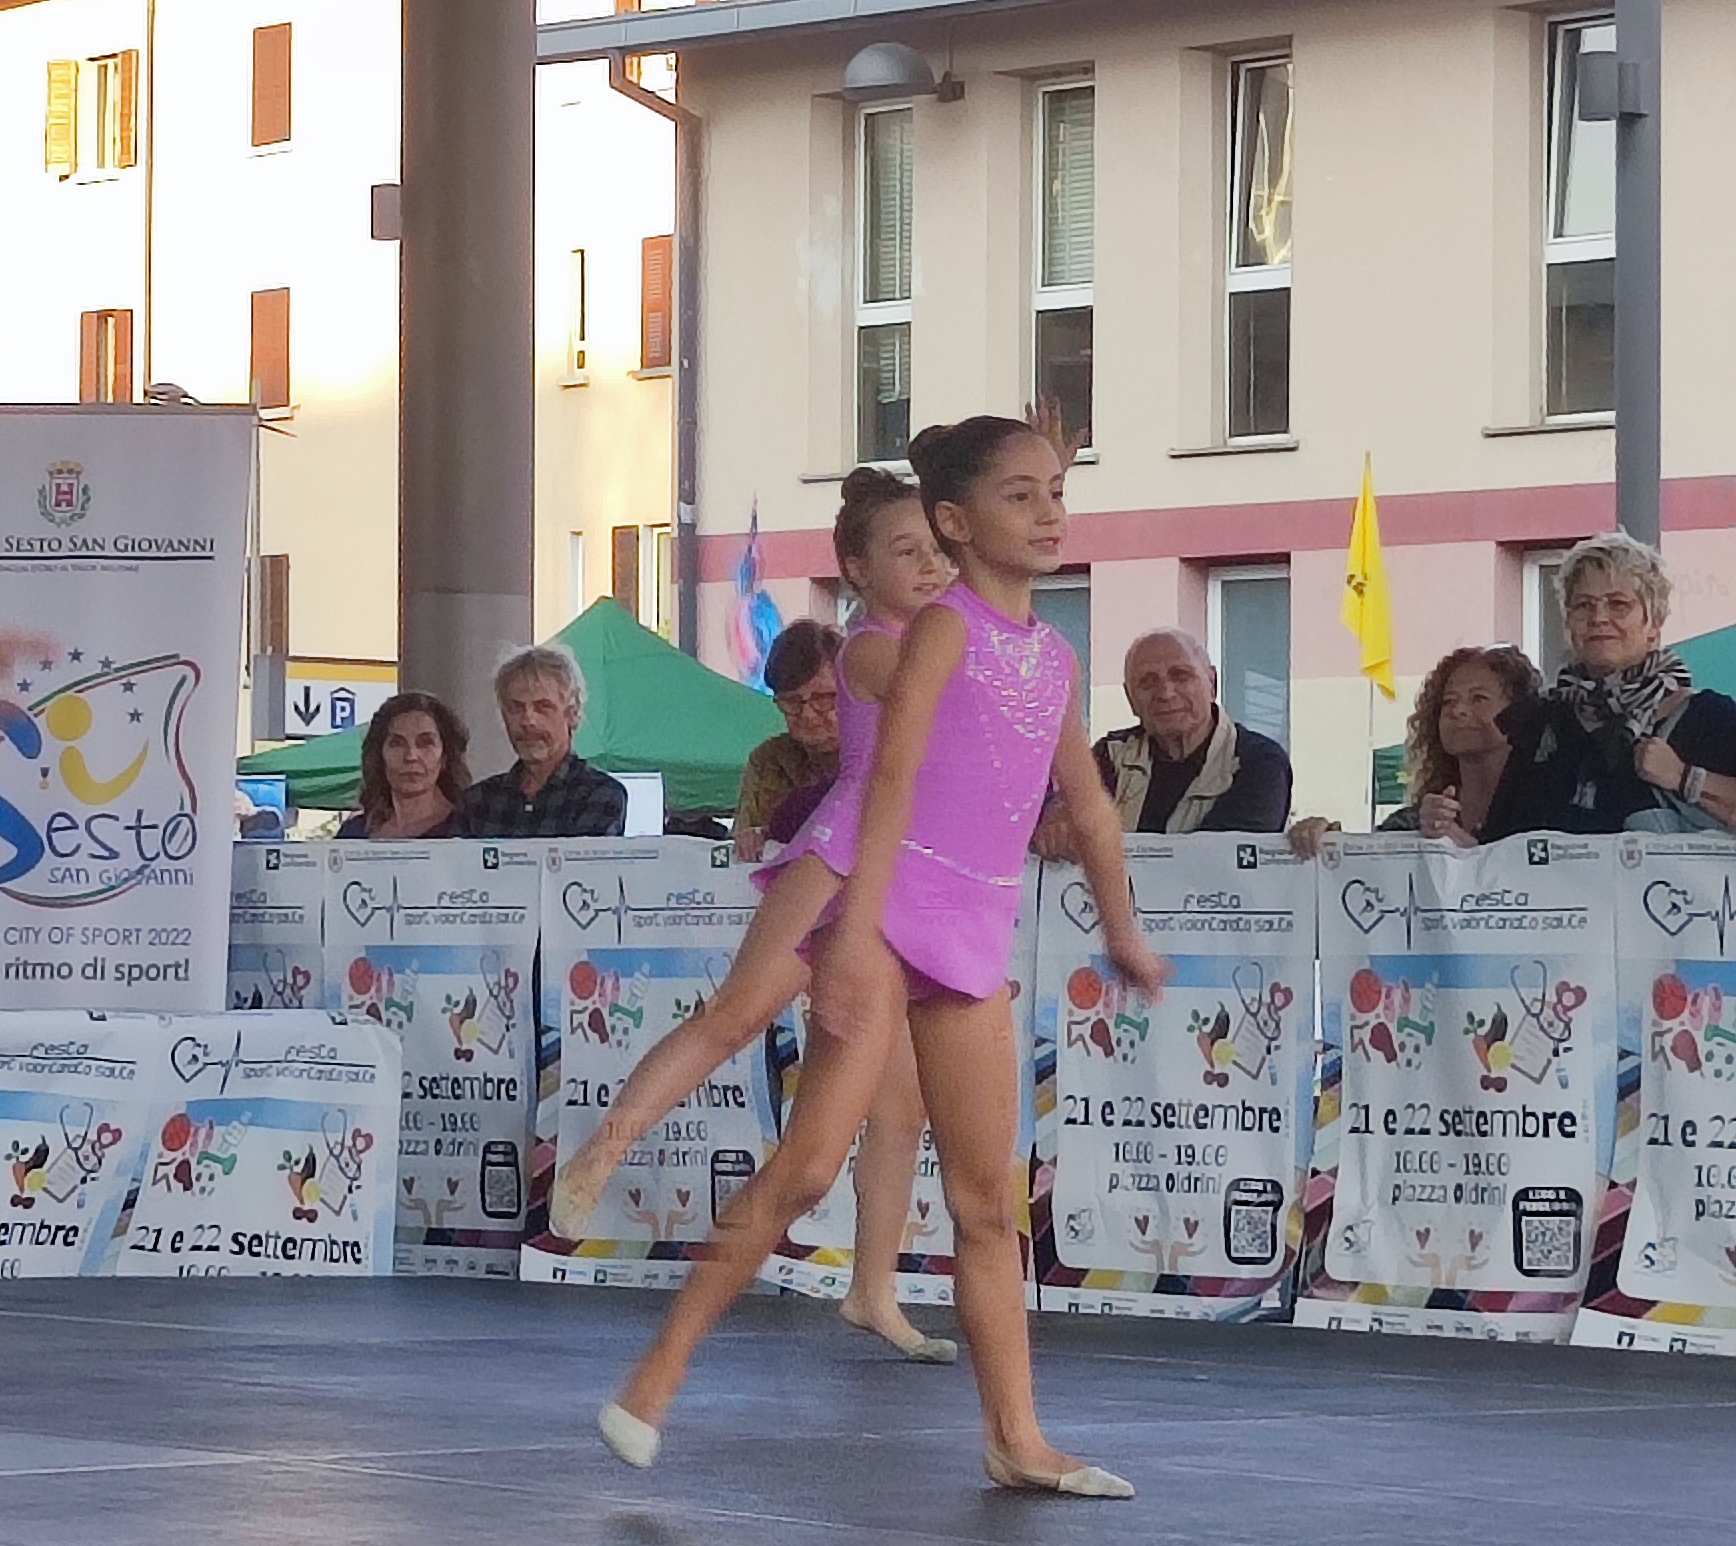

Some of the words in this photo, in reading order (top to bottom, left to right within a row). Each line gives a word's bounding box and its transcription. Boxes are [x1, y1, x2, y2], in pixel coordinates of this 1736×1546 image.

[3, 534, 63, 553] SESTO
[67, 534, 106, 553] SAN
[112, 534, 215, 553] GIOVANNI
[334, 699, 351, 726] P
[3, 927, 42, 946] CITY
[48, 927, 76, 946] OF
[82, 928, 142, 946] SPORT
[147, 928, 193, 946] 2022
[4, 957, 73, 981] ritmo
[80, 956, 106, 982] di
[113, 958, 190, 987] sport!
[418, 1071, 518, 1101] settembre
[566, 1078, 591, 1107] 21
[596, 1083, 610, 1107] e
[1064, 1094, 1093, 1126] 21
[1100, 1101, 1115, 1127] e
[1122, 1096, 1145, 1127] 22
[1150, 1099, 1282, 1133] settembre
[1348, 1102, 1375, 1135] 21
[1383, 1108, 1398, 1136] e
[1403, 1103, 1431, 1136] 22
[1438, 1104, 1578, 1139] settembre
[1646, 1112, 1673, 1147] 21
[1680, 1119, 1697, 1148] e
[1113, 1140, 1153, 1164] 10.00
[1174, 1143, 1228, 1166] 19.00
[1393, 1151, 1441, 1174] 10.00
[1463, 1153, 1510, 1176] 19.00
[1108, 1172, 1161, 1194] piazza
[1391, 1180, 1448, 1205] piazza
[130, 1226, 163, 1253] 21
[170, 1230, 184, 1254] e
[189, 1224, 222, 1252] 22
[228, 1229, 363, 1265] settembre
